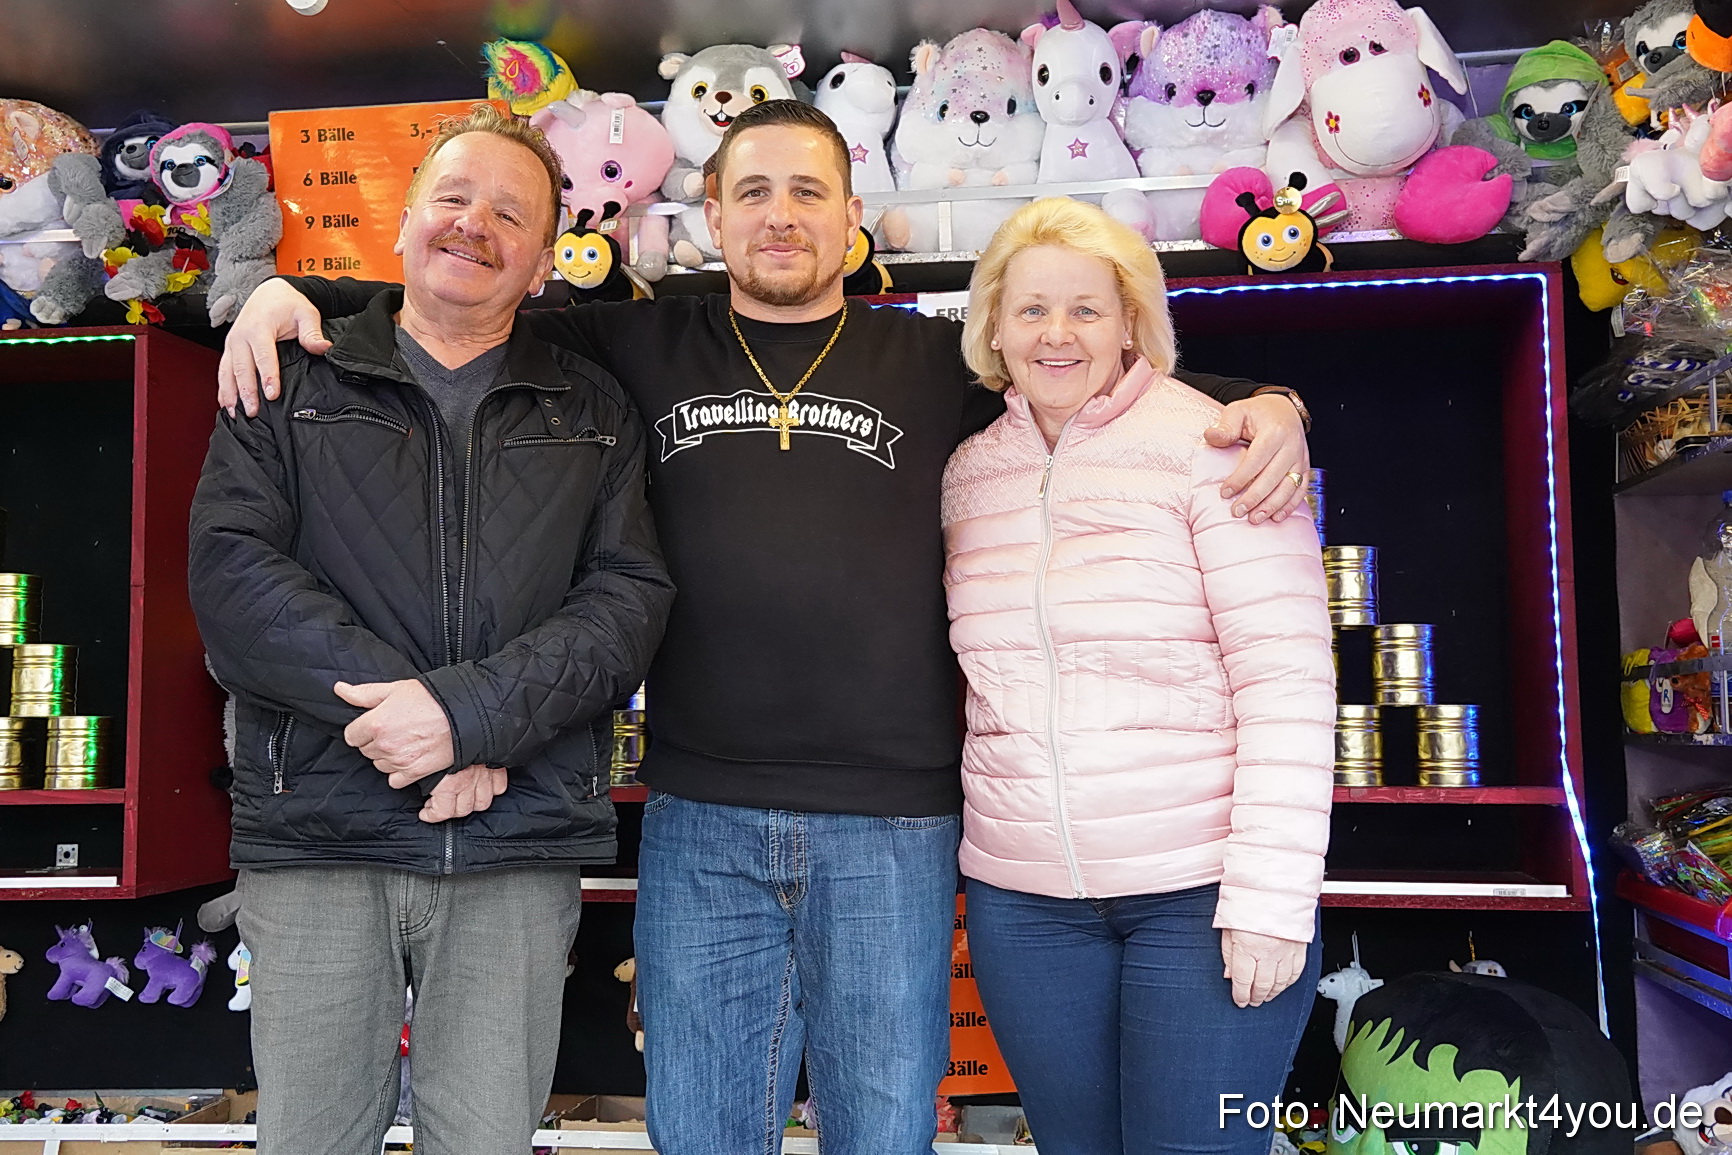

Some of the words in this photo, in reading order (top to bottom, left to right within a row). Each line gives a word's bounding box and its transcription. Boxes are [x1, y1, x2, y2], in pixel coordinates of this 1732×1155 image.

[300, 129, 311, 143] 3
[317, 127, 355, 143] Bälle
[303, 172, 313, 187] 6
[320, 171, 357, 186] Bälle
[305, 215, 316, 230] 9
[322, 213, 360, 229] Bälle
[296, 258, 316, 272] 12
[323, 256, 361, 271] Bälle
[787, 398, 874, 437] Brothers
